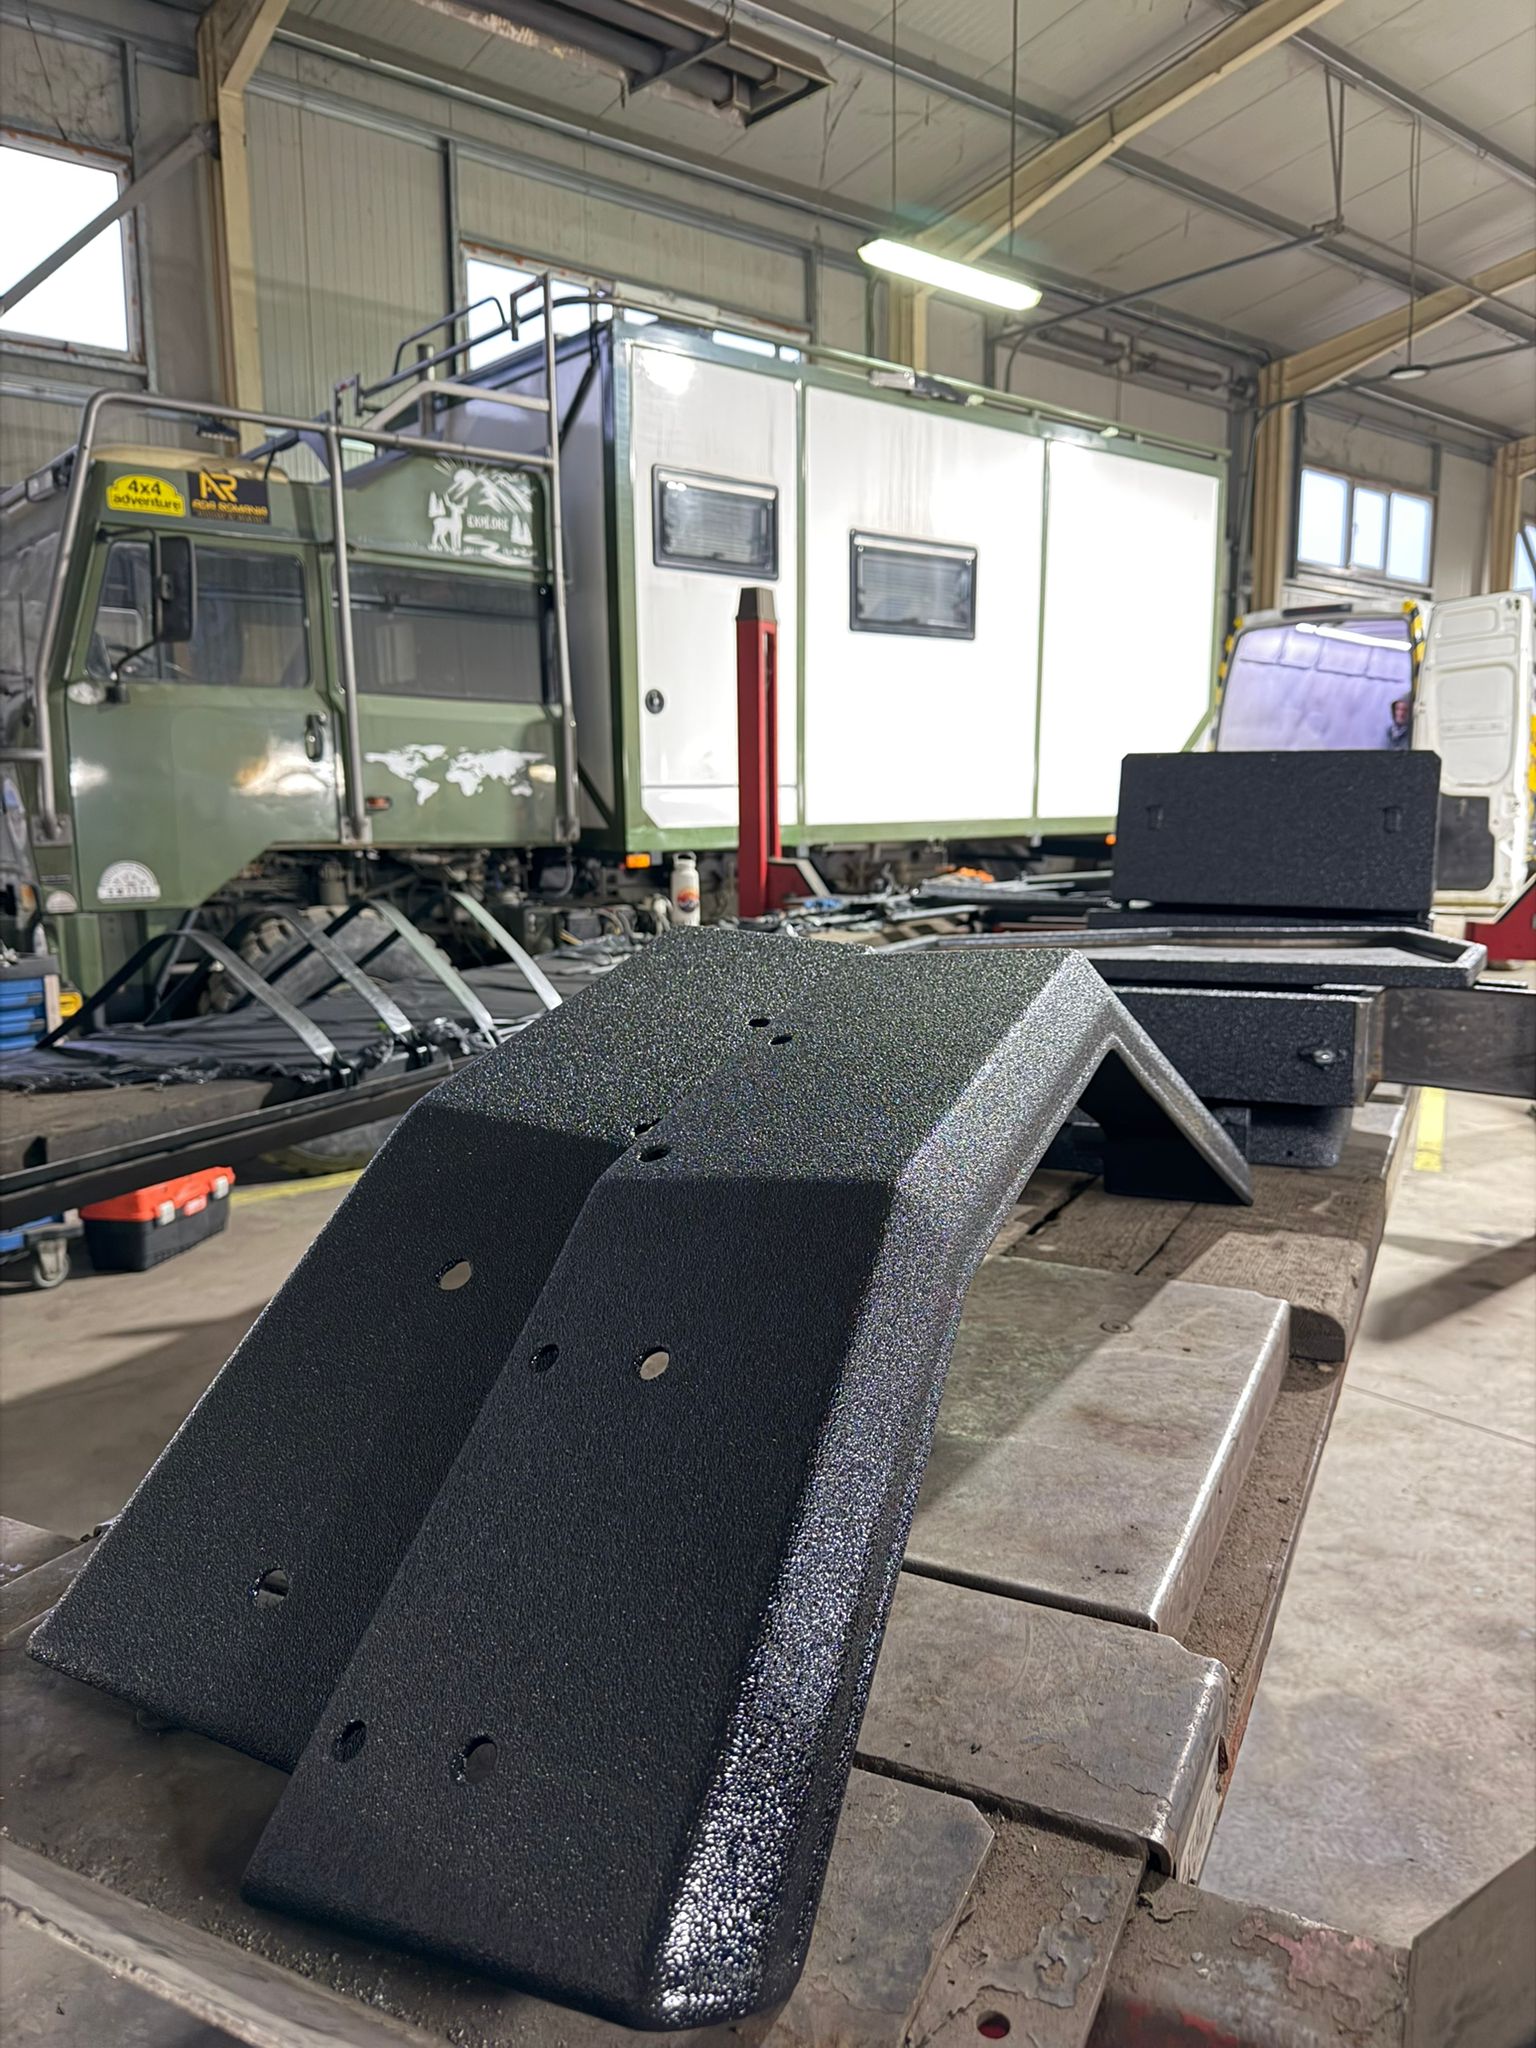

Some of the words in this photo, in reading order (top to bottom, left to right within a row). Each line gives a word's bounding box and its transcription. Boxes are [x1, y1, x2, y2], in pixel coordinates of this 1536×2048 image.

[128, 479, 161, 496] 4x4
[113, 494, 181, 511] adventure
[466, 513, 509, 532] EXPLORE
